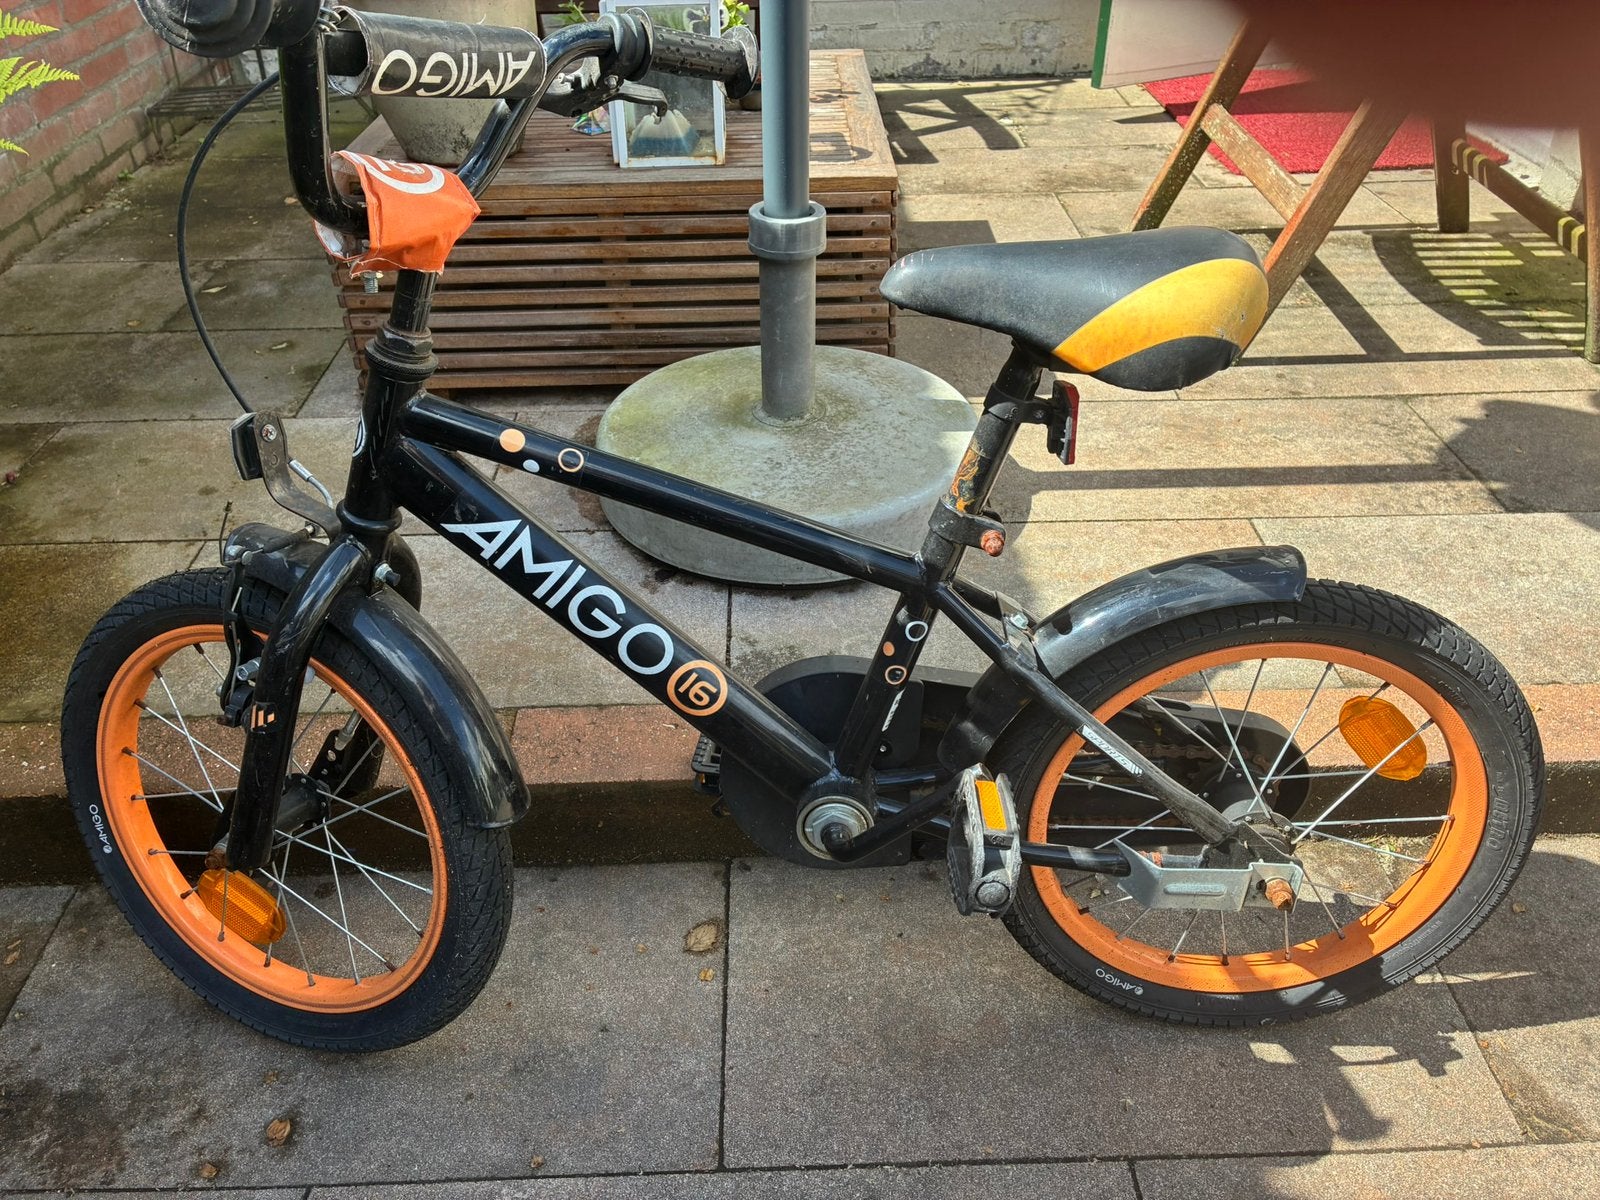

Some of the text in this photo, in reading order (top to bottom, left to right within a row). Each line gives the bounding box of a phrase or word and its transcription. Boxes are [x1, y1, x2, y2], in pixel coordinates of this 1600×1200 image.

[371, 49, 536, 97] AMIGO
[439, 519, 717, 706] AMIGO 16
[1086, 731, 1129, 766] SPORTS
[89, 804, 110, 845] AMIGO
[1095, 968, 1136, 990] AMIGO
